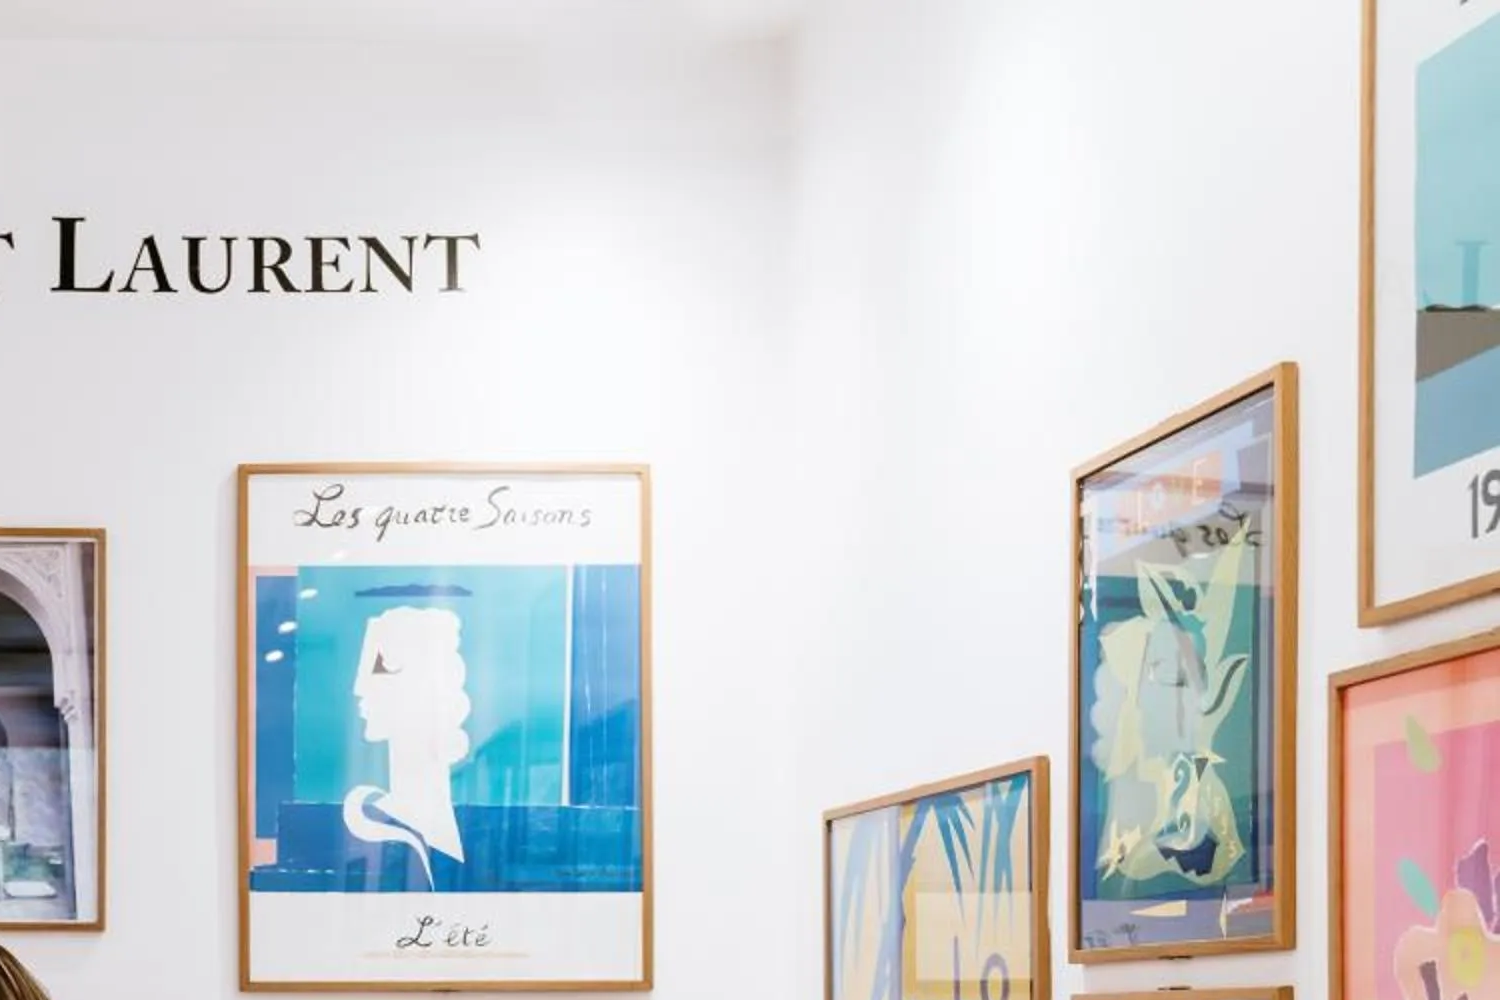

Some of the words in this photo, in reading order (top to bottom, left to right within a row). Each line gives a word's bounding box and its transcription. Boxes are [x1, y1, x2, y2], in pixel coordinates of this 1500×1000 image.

[51, 214, 481, 294] LAURENT
[293, 483, 362, 529] Les
[375, 504, 470, 542] quatre
[472, 486, 592, 531] Saisons
